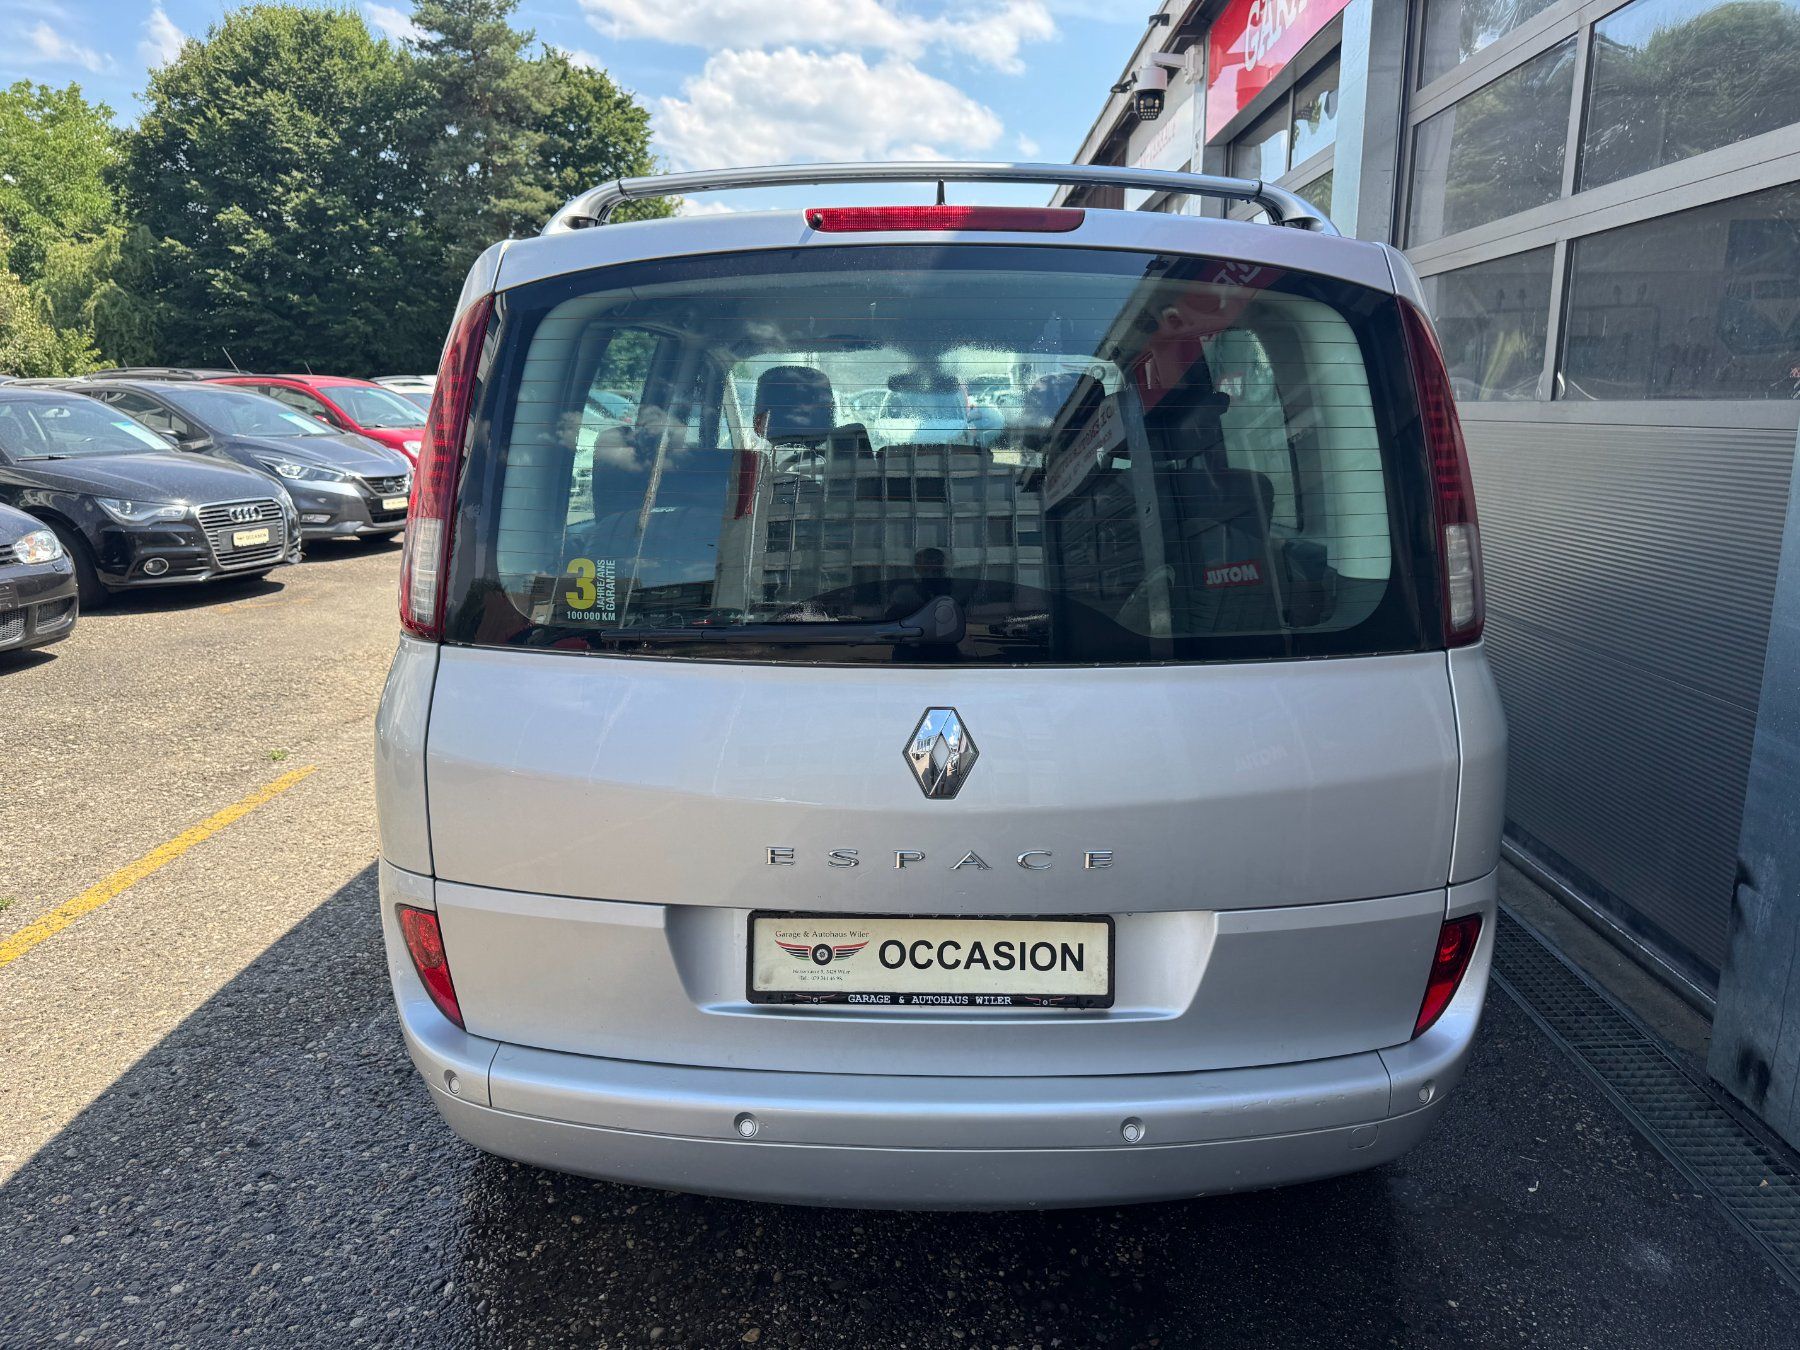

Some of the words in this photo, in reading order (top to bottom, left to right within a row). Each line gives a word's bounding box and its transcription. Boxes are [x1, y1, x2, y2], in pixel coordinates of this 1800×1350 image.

[565, 557, 597, 610] 3
[597, 559, 606, 611] JAHRE/ANS
[606, 559, 616, 611] GARANTIE
[566, 611, 584, 620] 100
[585, 611, 601, 620] 000
[602, 612, 616, 621] KM
[765, 846, 1114, 871] ESPACE
[775, 930, 801, 939] Garage
[803, 930, 810, 938] &
[812, 930, 848, 938] Autohaus
[849, 930, 870, 938] Wiler
[878, 939, 1086, 973] OCCASION
[848, 994, 891, 1004] GARAGE
[898, 995, 905, 1004] &
[911, 995, 969, 1005] AUTOHAUS
[975, 995, 1013, 1005] WILER
